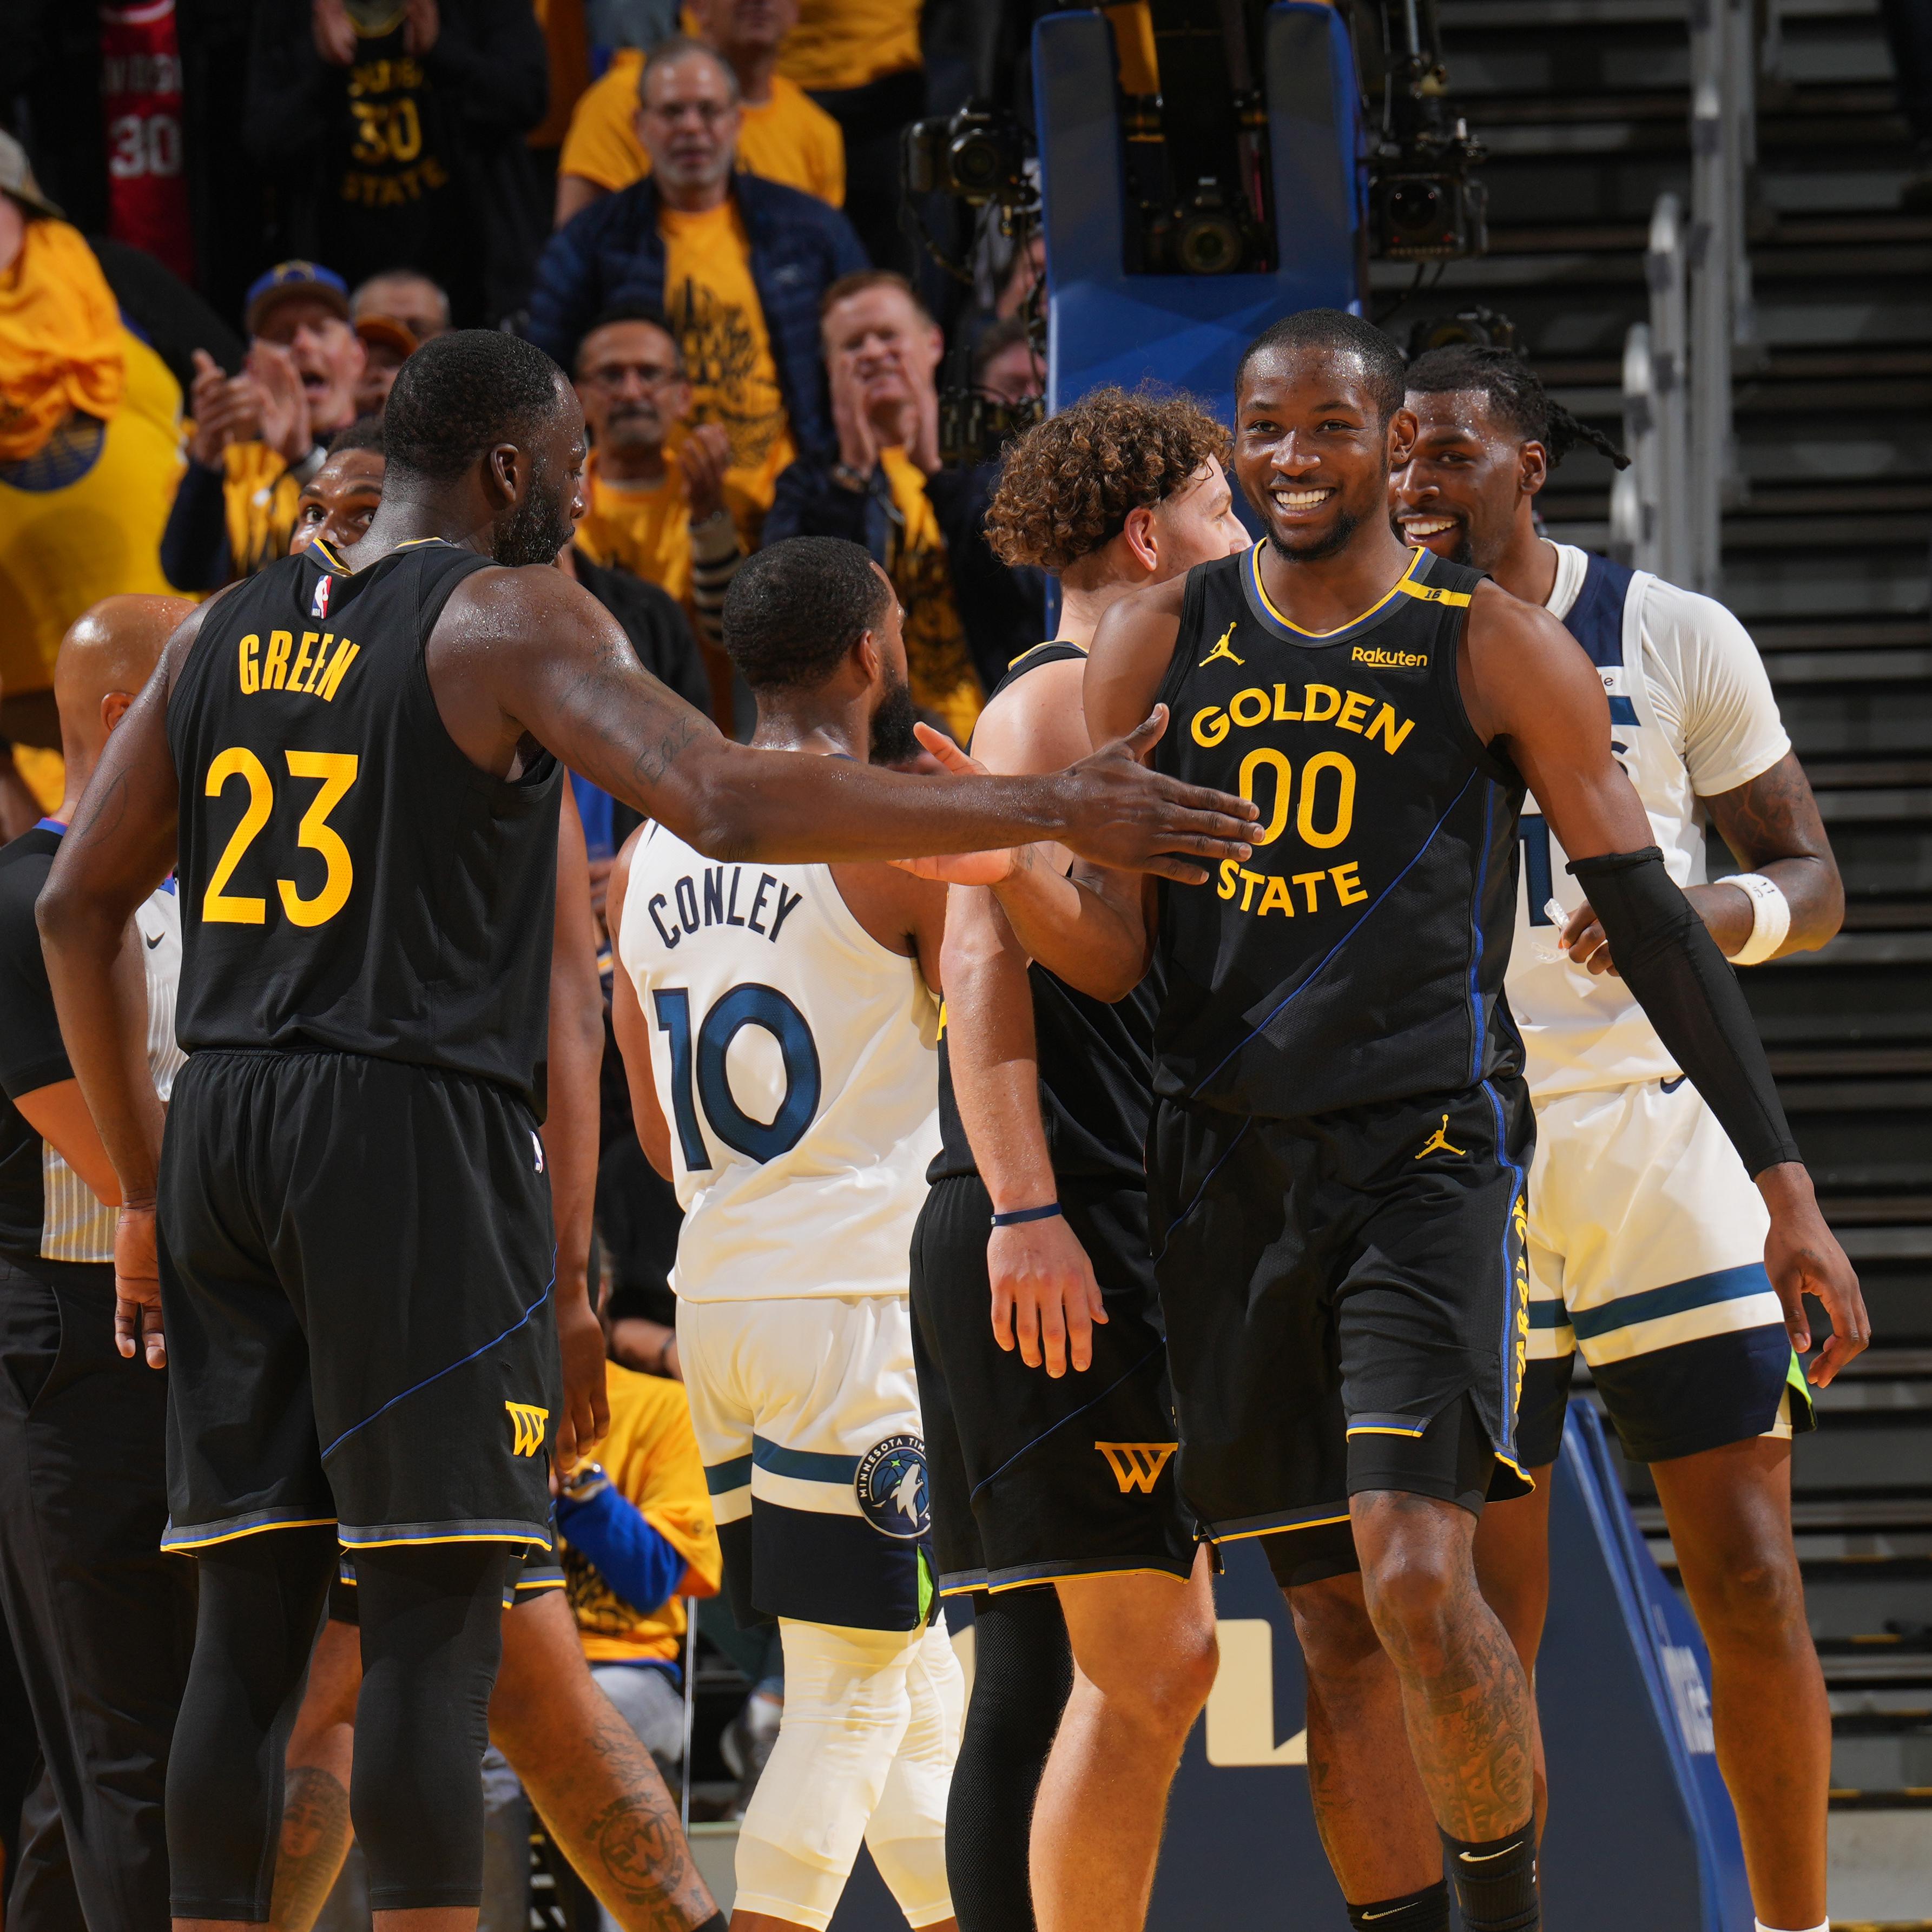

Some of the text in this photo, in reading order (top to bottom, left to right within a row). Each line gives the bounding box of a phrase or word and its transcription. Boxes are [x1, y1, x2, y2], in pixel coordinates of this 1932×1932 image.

[110, 114, 183, 179] 30
[351, 97, 423, 164] 30
[1425, 590, 1442, 599] 16
[239, 630, 360, 702] GREEN
[1351, 647, 1428, 667] Rakuten
[1191, 683, 1415, 755] GOLDEN
[1239, 747, 1356, 849] 00
[202, 746, 359, 927] 23
[648, 866, 803, 949] CONLEY
[1217, 858, 1369, 917] STATE
[652, 982, 822, 1171] 10
[860, 1438, 904, 1498] MINNESOTA
